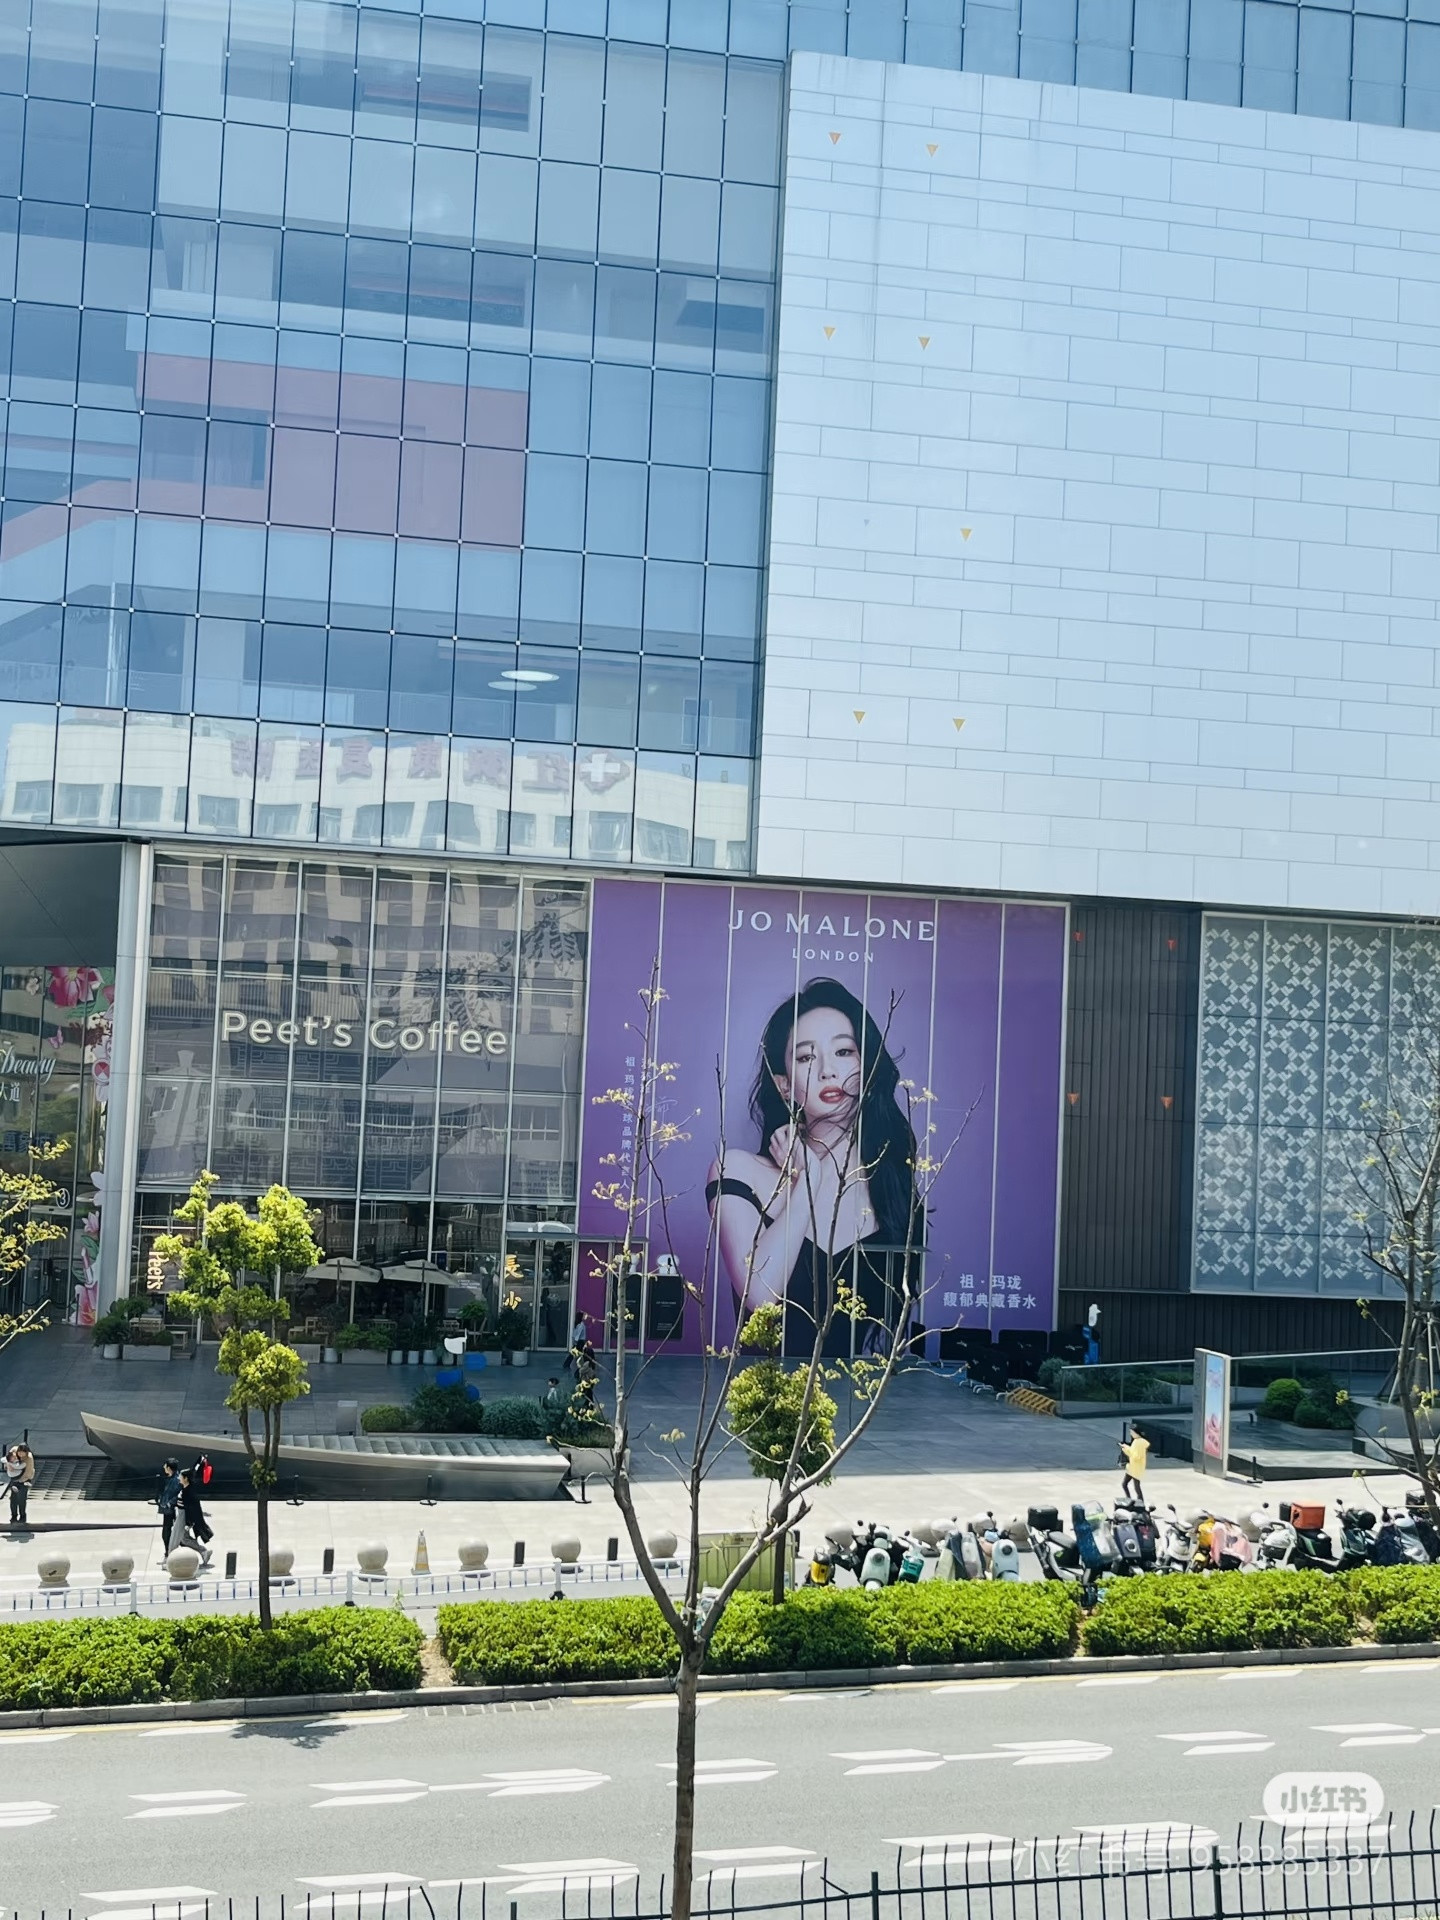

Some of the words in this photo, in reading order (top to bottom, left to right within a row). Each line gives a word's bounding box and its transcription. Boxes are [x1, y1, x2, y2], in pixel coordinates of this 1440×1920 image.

[729, 909, 772, 932] JO
[786, 912, 935, 941] MALONE
[792, 948, 874, 963] LONDON
[369, 1018, 508, 1054] Coffee
[960, 1274, 1022, 1290] 祖·玛珑
[943, 1292, 1036, 1309] 馥郁典藏香水
